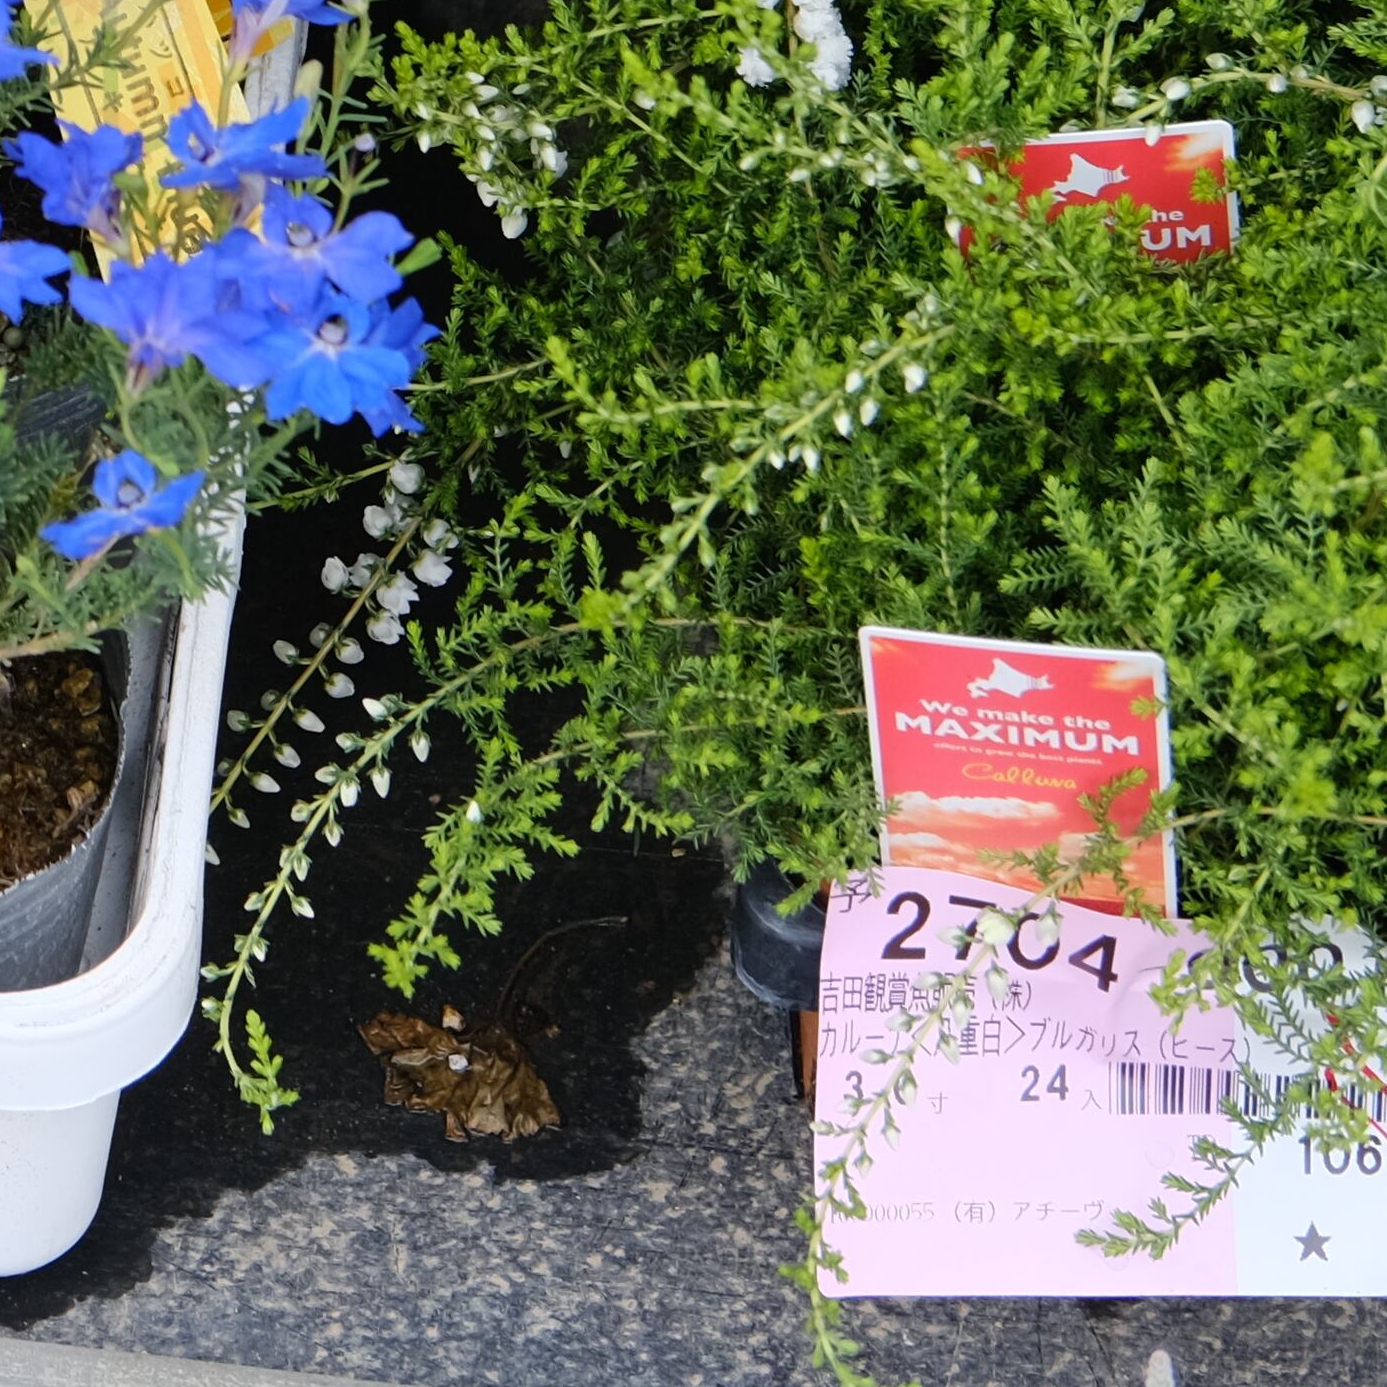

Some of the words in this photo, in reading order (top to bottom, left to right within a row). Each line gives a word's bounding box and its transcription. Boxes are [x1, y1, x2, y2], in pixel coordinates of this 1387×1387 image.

[894, 711, 1140, 756] MAXIMUM
[919, 699, 968, 718] We
[977, 708, 1054, 727] make
[1064, 716, 1111, 731] the
[927, 1091, 949, 1115] 寸
[1020, 1064, 1069, 1102] 24
[1081, 1090, 1102, 1111] 入
